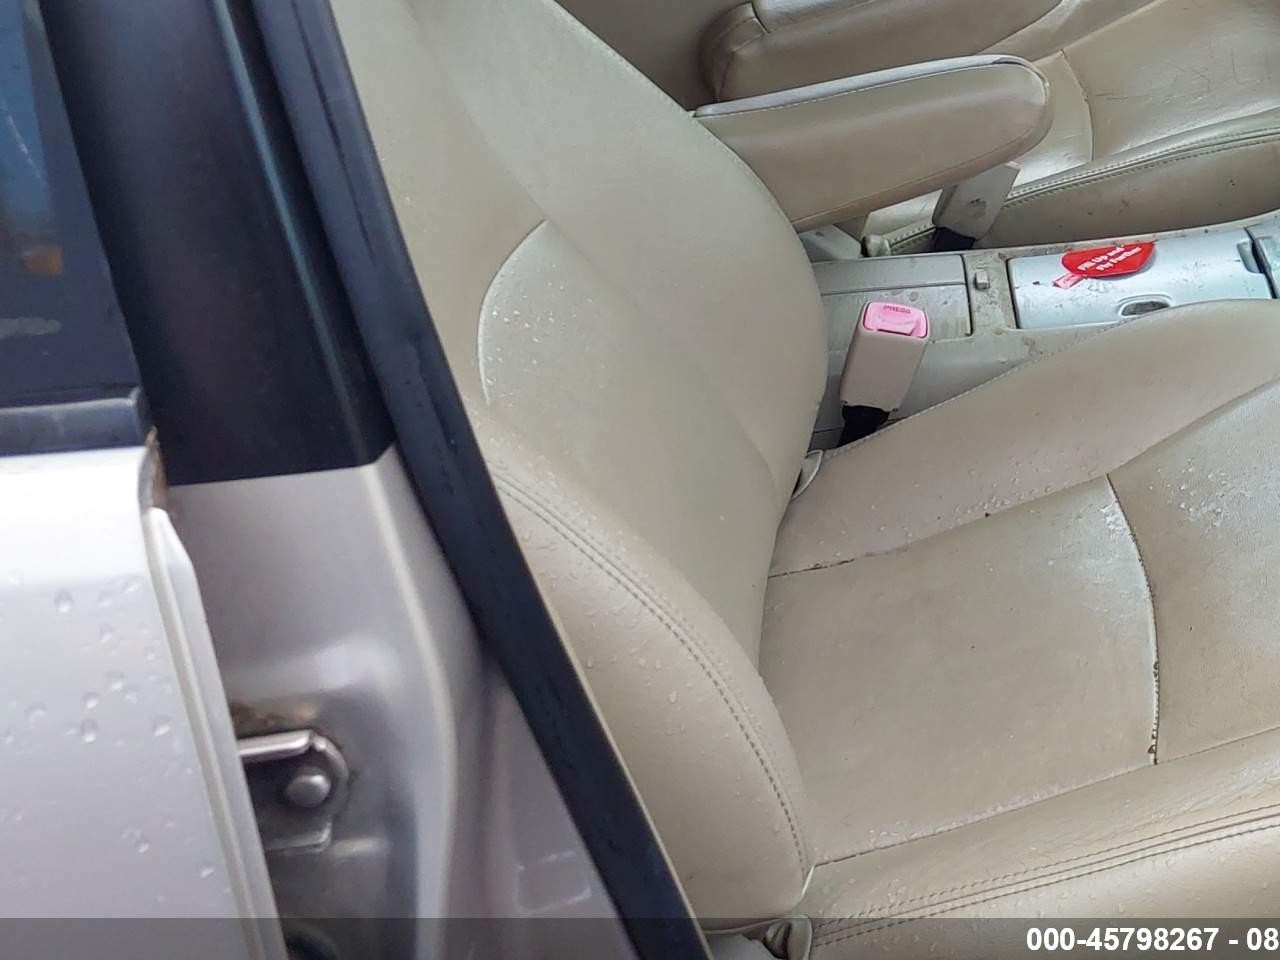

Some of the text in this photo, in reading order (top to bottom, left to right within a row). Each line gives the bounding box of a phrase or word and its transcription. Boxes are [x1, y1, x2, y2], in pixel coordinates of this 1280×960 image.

[1077, 261, 1096, 271] Fill
[1091, 255, 1109, 263] Up
[1095, 262, 1115, 271] Fly
[883, 305, 912, 315] PRESS
